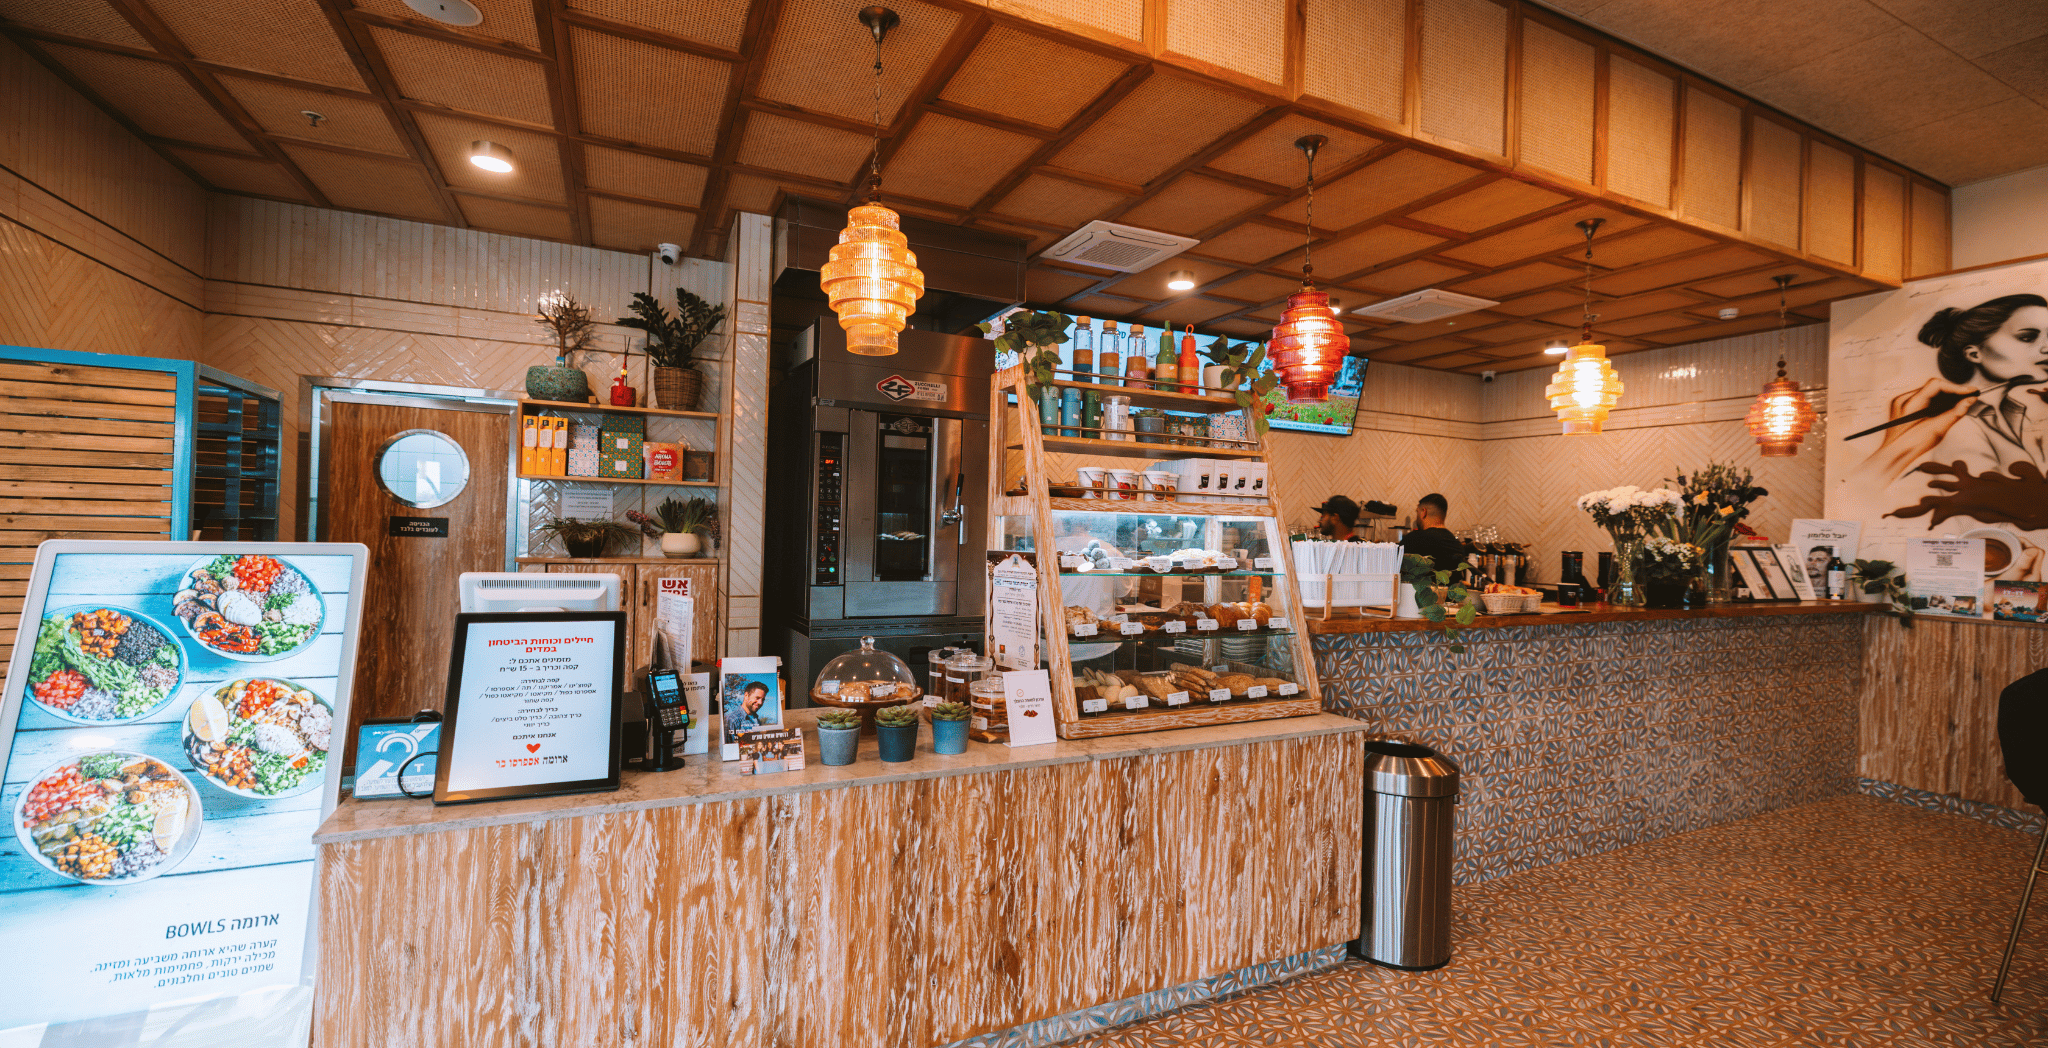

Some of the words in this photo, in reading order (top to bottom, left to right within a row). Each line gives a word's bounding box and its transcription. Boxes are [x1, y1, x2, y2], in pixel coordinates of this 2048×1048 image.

[662, 580, 688, 589] אש
[488, 639, 528, 647] הביטחון
[564, 636, 594, 644] חיילים
[496, 759, 506, 768] בר
[509, 757, 540, 767] אספרסו
[542, 755, 568, 764] ארומה
[414, 764, 424, 773] T
[230, 912, 280, 931] ארומה
[165, 918, 226, 940] BOWLS
[218, 943, 247, 954] שהיא
[249, 939, 278, 950] קערה
[134, 952, 179, 966] משביעה
[181, 947, 216, 960] ארוחה
[244, 950, 276, 963] מכילה
[90, 959, 130, 973] ומזינה.
[153, 961, 203, 976] פחמימות
[206, 956, 242, 970] ירקות,
[241, 963, 274, 975] שמנים
[108, 969, 150, 984] מלאות,
[153, 972, 204, 988] וחלבונים.
[208, 968, 238, 980] טובים
